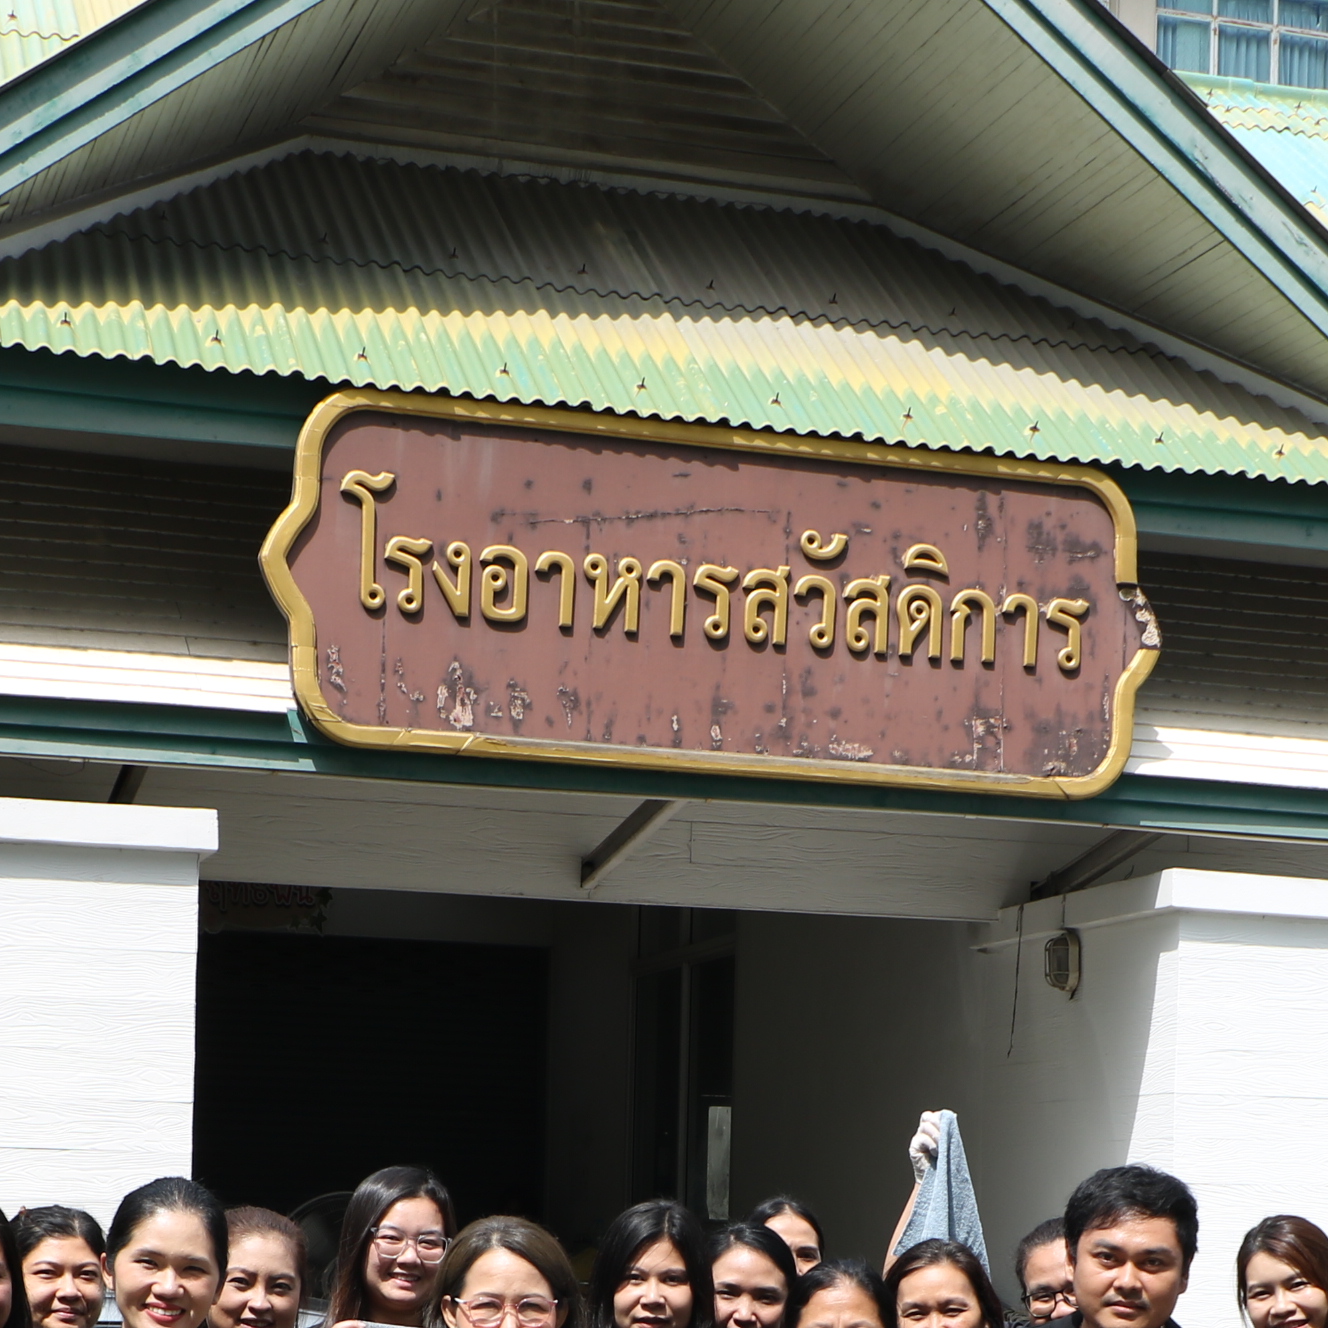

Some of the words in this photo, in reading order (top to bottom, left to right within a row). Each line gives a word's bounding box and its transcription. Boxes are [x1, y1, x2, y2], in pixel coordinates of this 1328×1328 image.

[340, 469, 1090, 671] โรงอาหารสวัสดิการ
